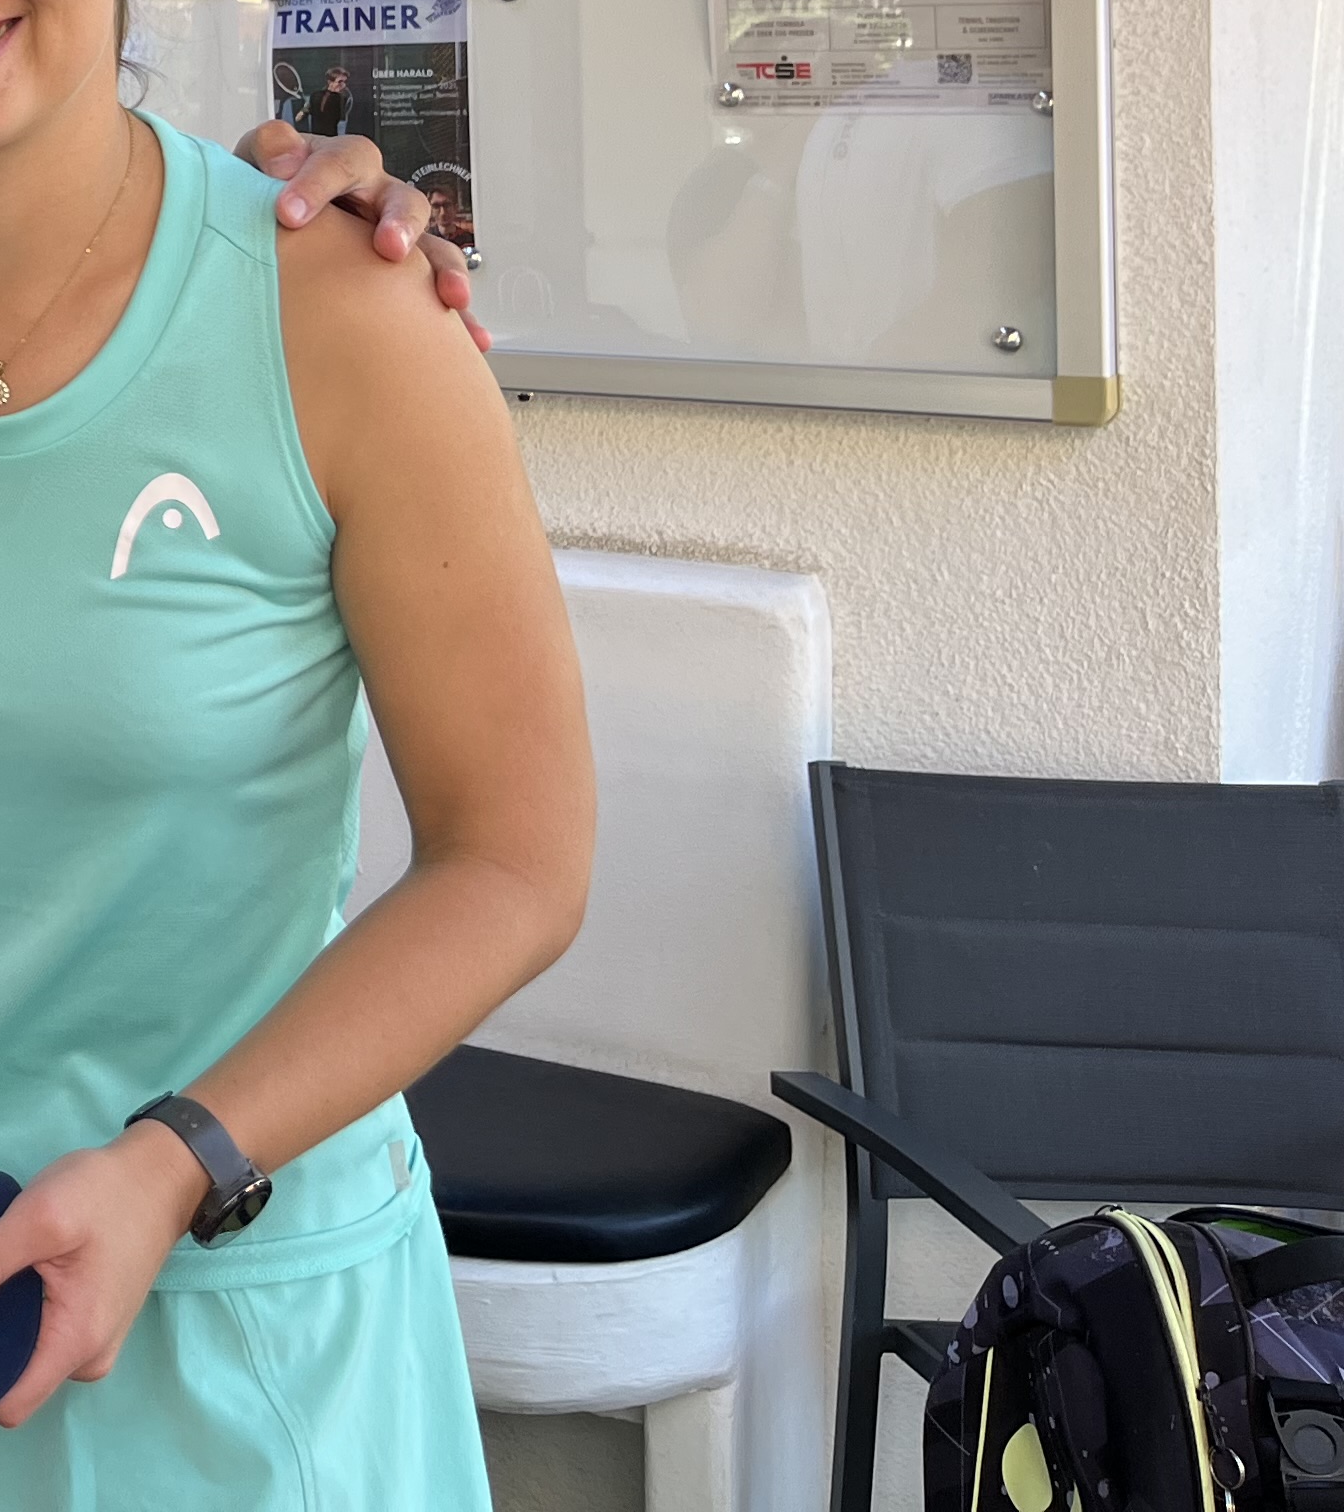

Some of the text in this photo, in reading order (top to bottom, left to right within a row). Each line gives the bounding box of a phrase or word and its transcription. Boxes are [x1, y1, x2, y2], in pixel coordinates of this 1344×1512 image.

[277, 5, 421, 34] TRAINER
[372, 67, 433, 78] ÜBER HARALD
